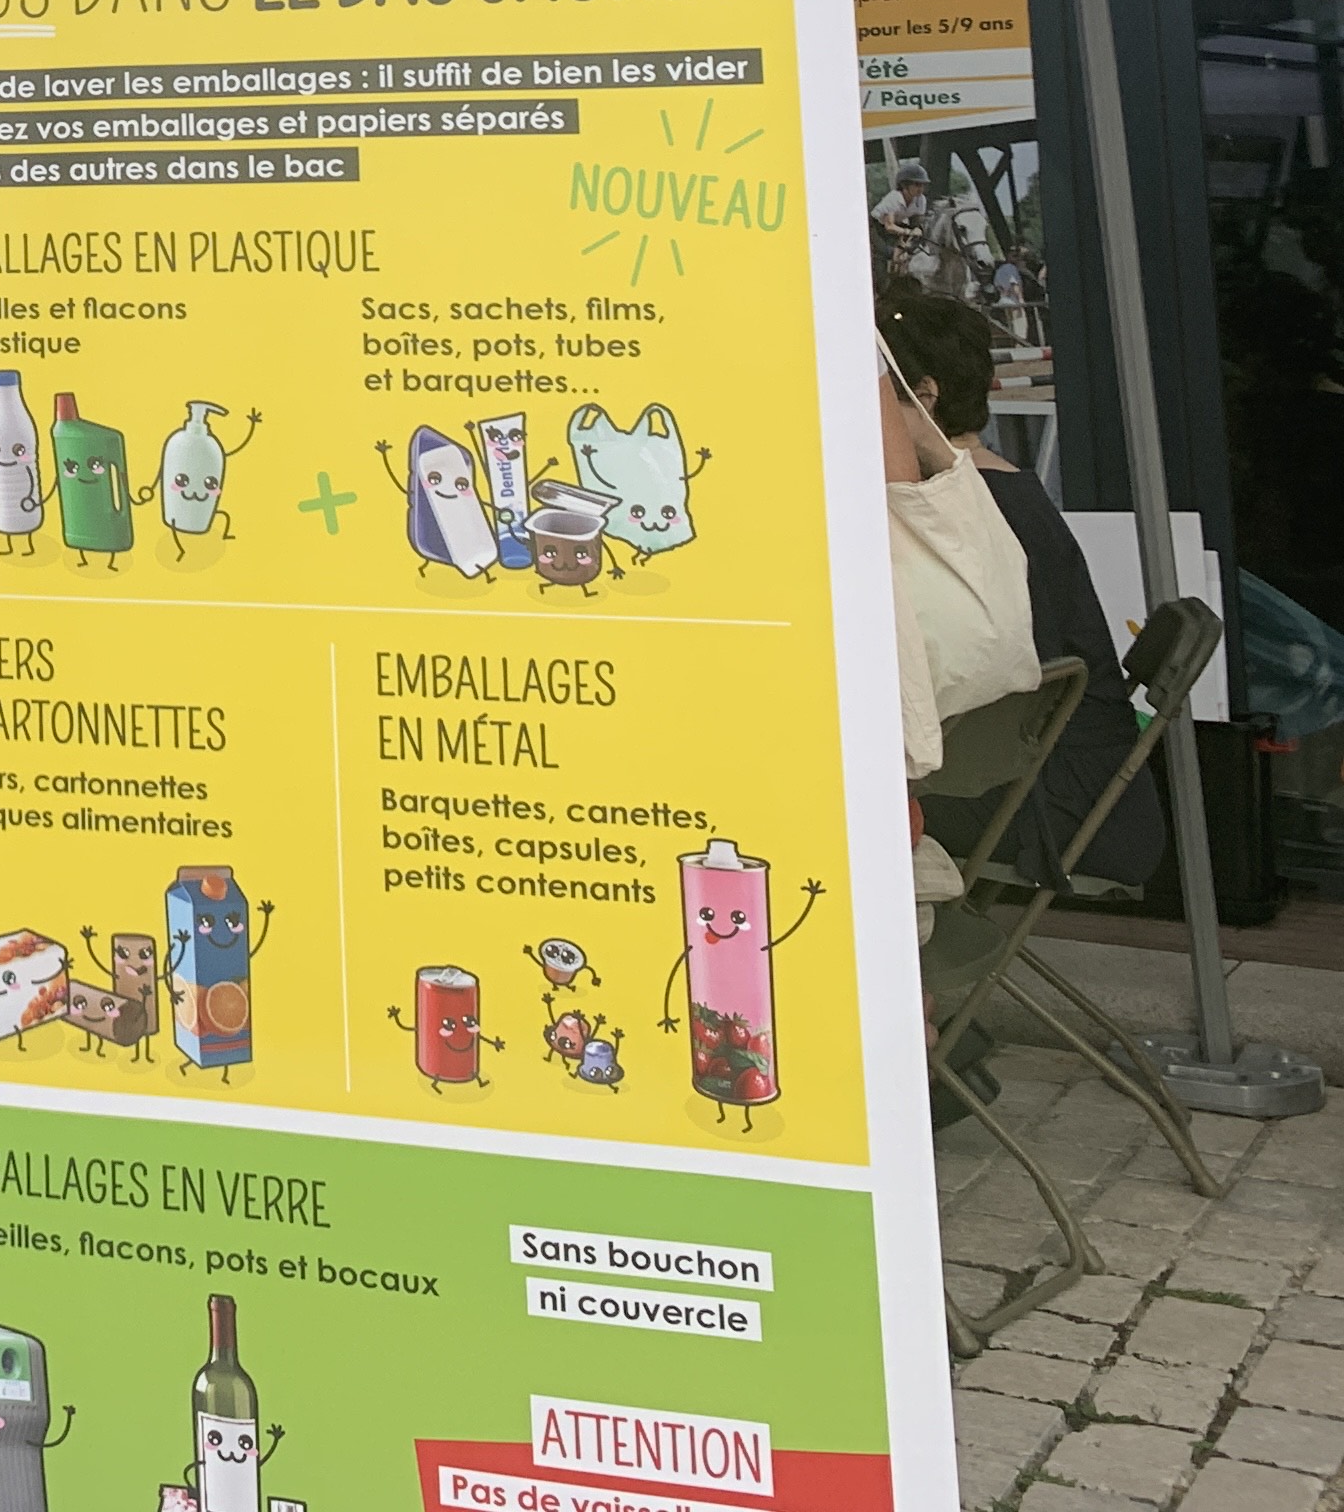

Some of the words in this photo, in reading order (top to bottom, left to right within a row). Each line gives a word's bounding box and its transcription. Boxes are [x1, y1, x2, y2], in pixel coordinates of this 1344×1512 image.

[858, 24, 900, 42] pour
[907, 20, 932, 34] les
[938, 17, 973, 34] 5/9
[979, 18, 1014, 31] ans
[0, 76, 35, 97] de
[45, 75, 115, 96] laver
[125, 72, 163, 94] les
[173, 68, 351, 93] emballages
[362, 71, 368, 88] :
[379, 64, 393, 87] il
[404, 62, 471, 87] suffit
[482, 62, 522, 85] de
[534, 60, 602, 84] bien
[613, 59, 656, 82] les
[666, 56, 748, 80] vider
[859, 57, 909, 79] 'été
[880, 88, 962, 110] Pâques
[37, 121, 83, 139] vos
[93, 113, 269, 140] emballages
[279, 111, 307, 133] et
[318, 108, 431, 138] papiers
[441, 104, 564, 135] séparés
[11, 160, 60, 182] des
[70, 158, 157, 180] autres
[168, 156, 238, 179] dans
[249, 155, 274, 178] le
[285, 154, 344, 177] bac
[570, 163, 786, 233] NOUVEAU
[135, 232, 176, 272] EN
[190, 230, 379, 278] PLASTIQUE
[50, 298, 75, 319] et
[83, 297, 186, 319] flacons
[362, 297, 438, 322] Sacs,
[451, 297, 575, 323] sachets,
[586, 297, 664, 323] films,
[363, 332, 461, 358] boîtes,
[473, 334, 544, 361] pots,
[556, 334, 641, 357] tubes
[365, 369, 393, 391] et
[403, 369, 599, 397] barquettes...
[377, 652, 615, 706] EMBALLAGES
[379, 716, 423, 761] EN
[438, 714, 559, 768] MÉTAL
[34, 772, 207, 800] cartonnettes
[63, 808, 232, 838] alimentaires
[382, 788, 554, 823] Barquettes,
[567, 803, 716, 833] canettes,
[383, 825, 482, 857] boîtes,
[495, 838, 645, 867] capsules,
[385, 865, 465, 892] petits
[477, 873, 655, 903] contenants
[163, 1165, 204, 1213] EN
[217, 1170, 330, 1228] VERRE
[80, 1232, 194, 1269] flacons,
[207, 1249, 267, 1275] pots
[279, 1256, 307, 1279] et
[318, 1258, 439, 1296] bocaux
[523, 1233, 596, 1264] Sans
[609, 1242, 759, 1282] bouchon
[540, 1286, 566, 1312] ni
[578, 1296, 747, 1332] couvercle
[541, 1407, 762, 1484] ATTENTION
[451, 1474, 507, 1506] Pas
[517, 1485, 560, 1512] de
